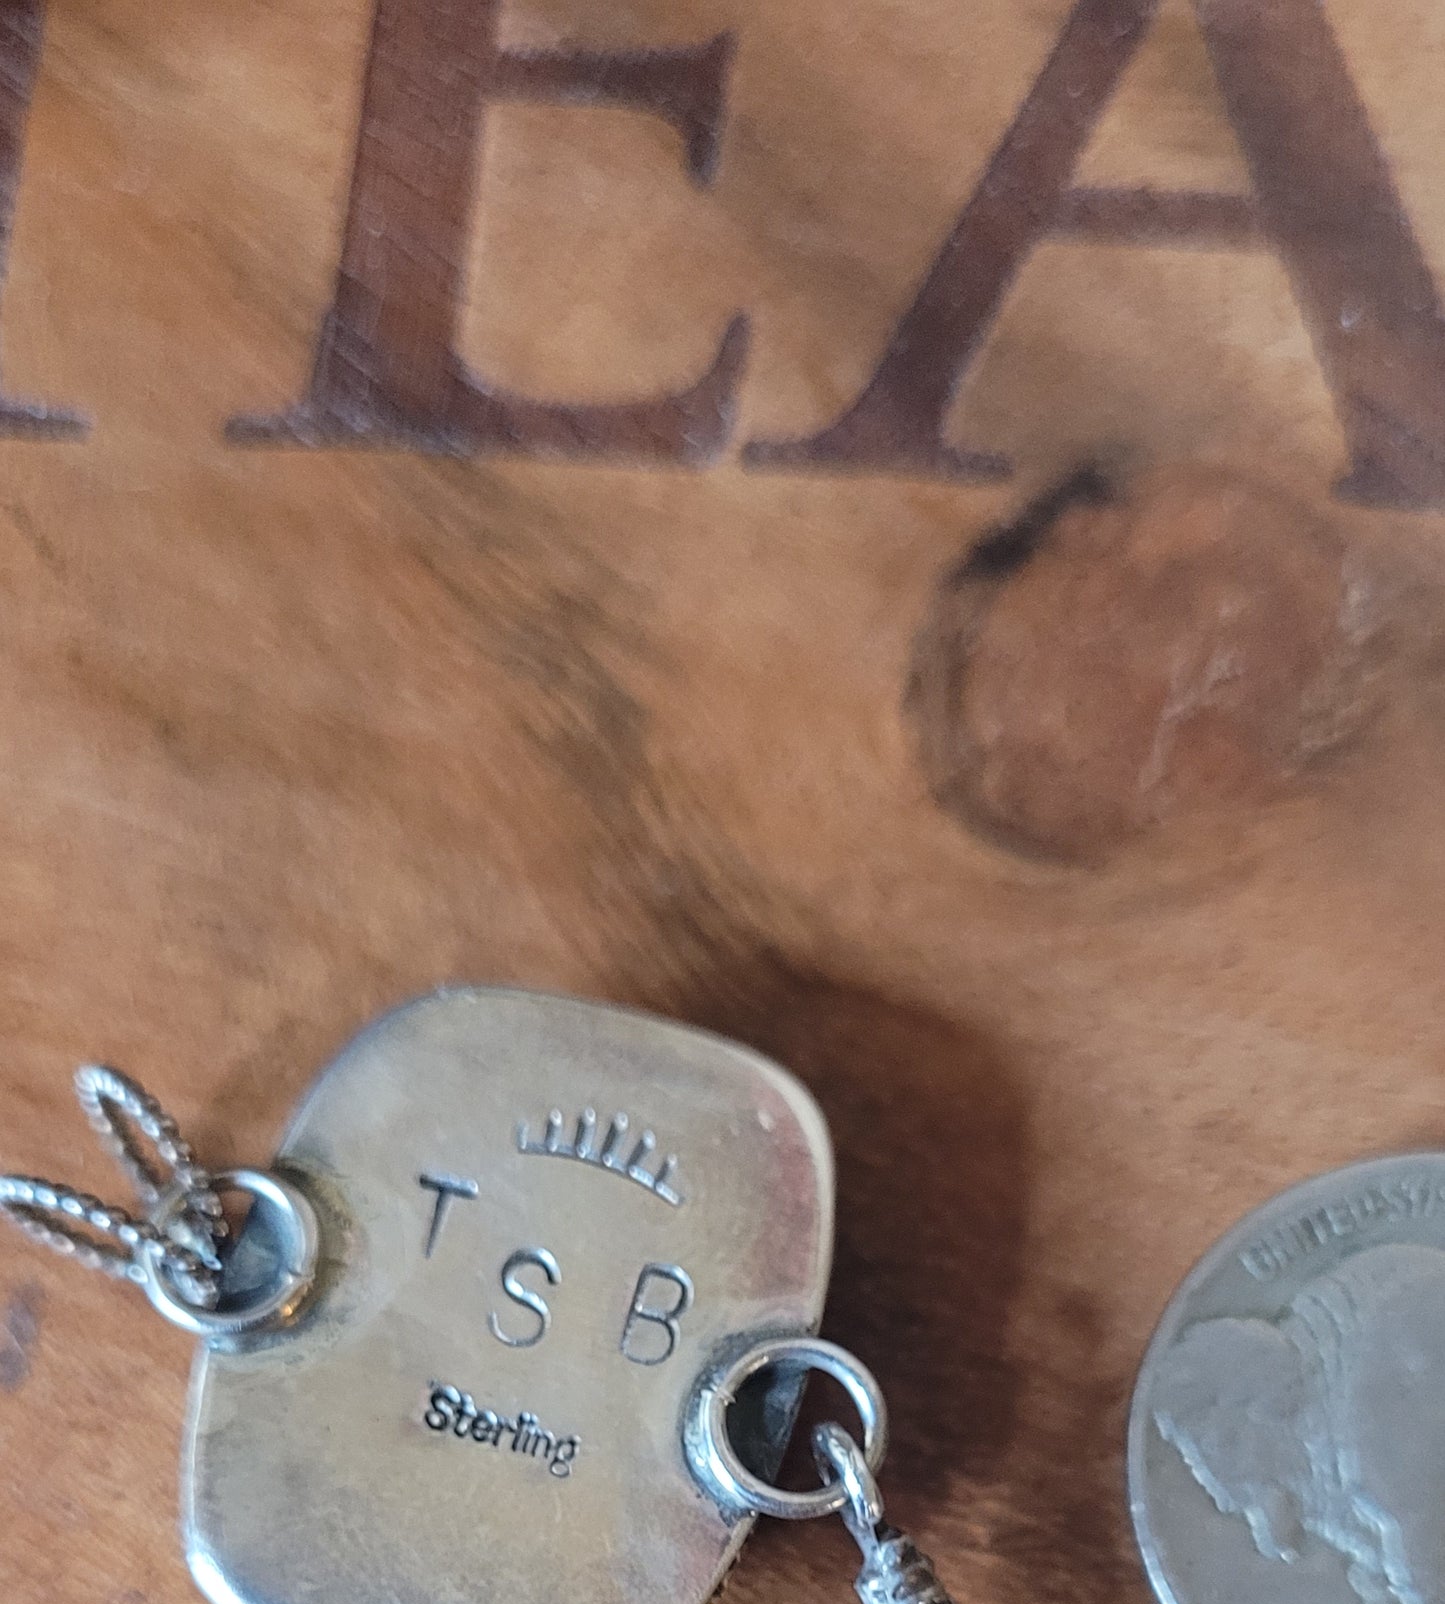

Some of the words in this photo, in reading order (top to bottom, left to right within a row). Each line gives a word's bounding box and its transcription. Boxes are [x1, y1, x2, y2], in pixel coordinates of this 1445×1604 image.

[419, 1169, 480, 1260] T
[488, 1246, 562, 1347] S
[620, 1261, 695, 1366] B
[424, 1381, 581, 1478] Sterling
